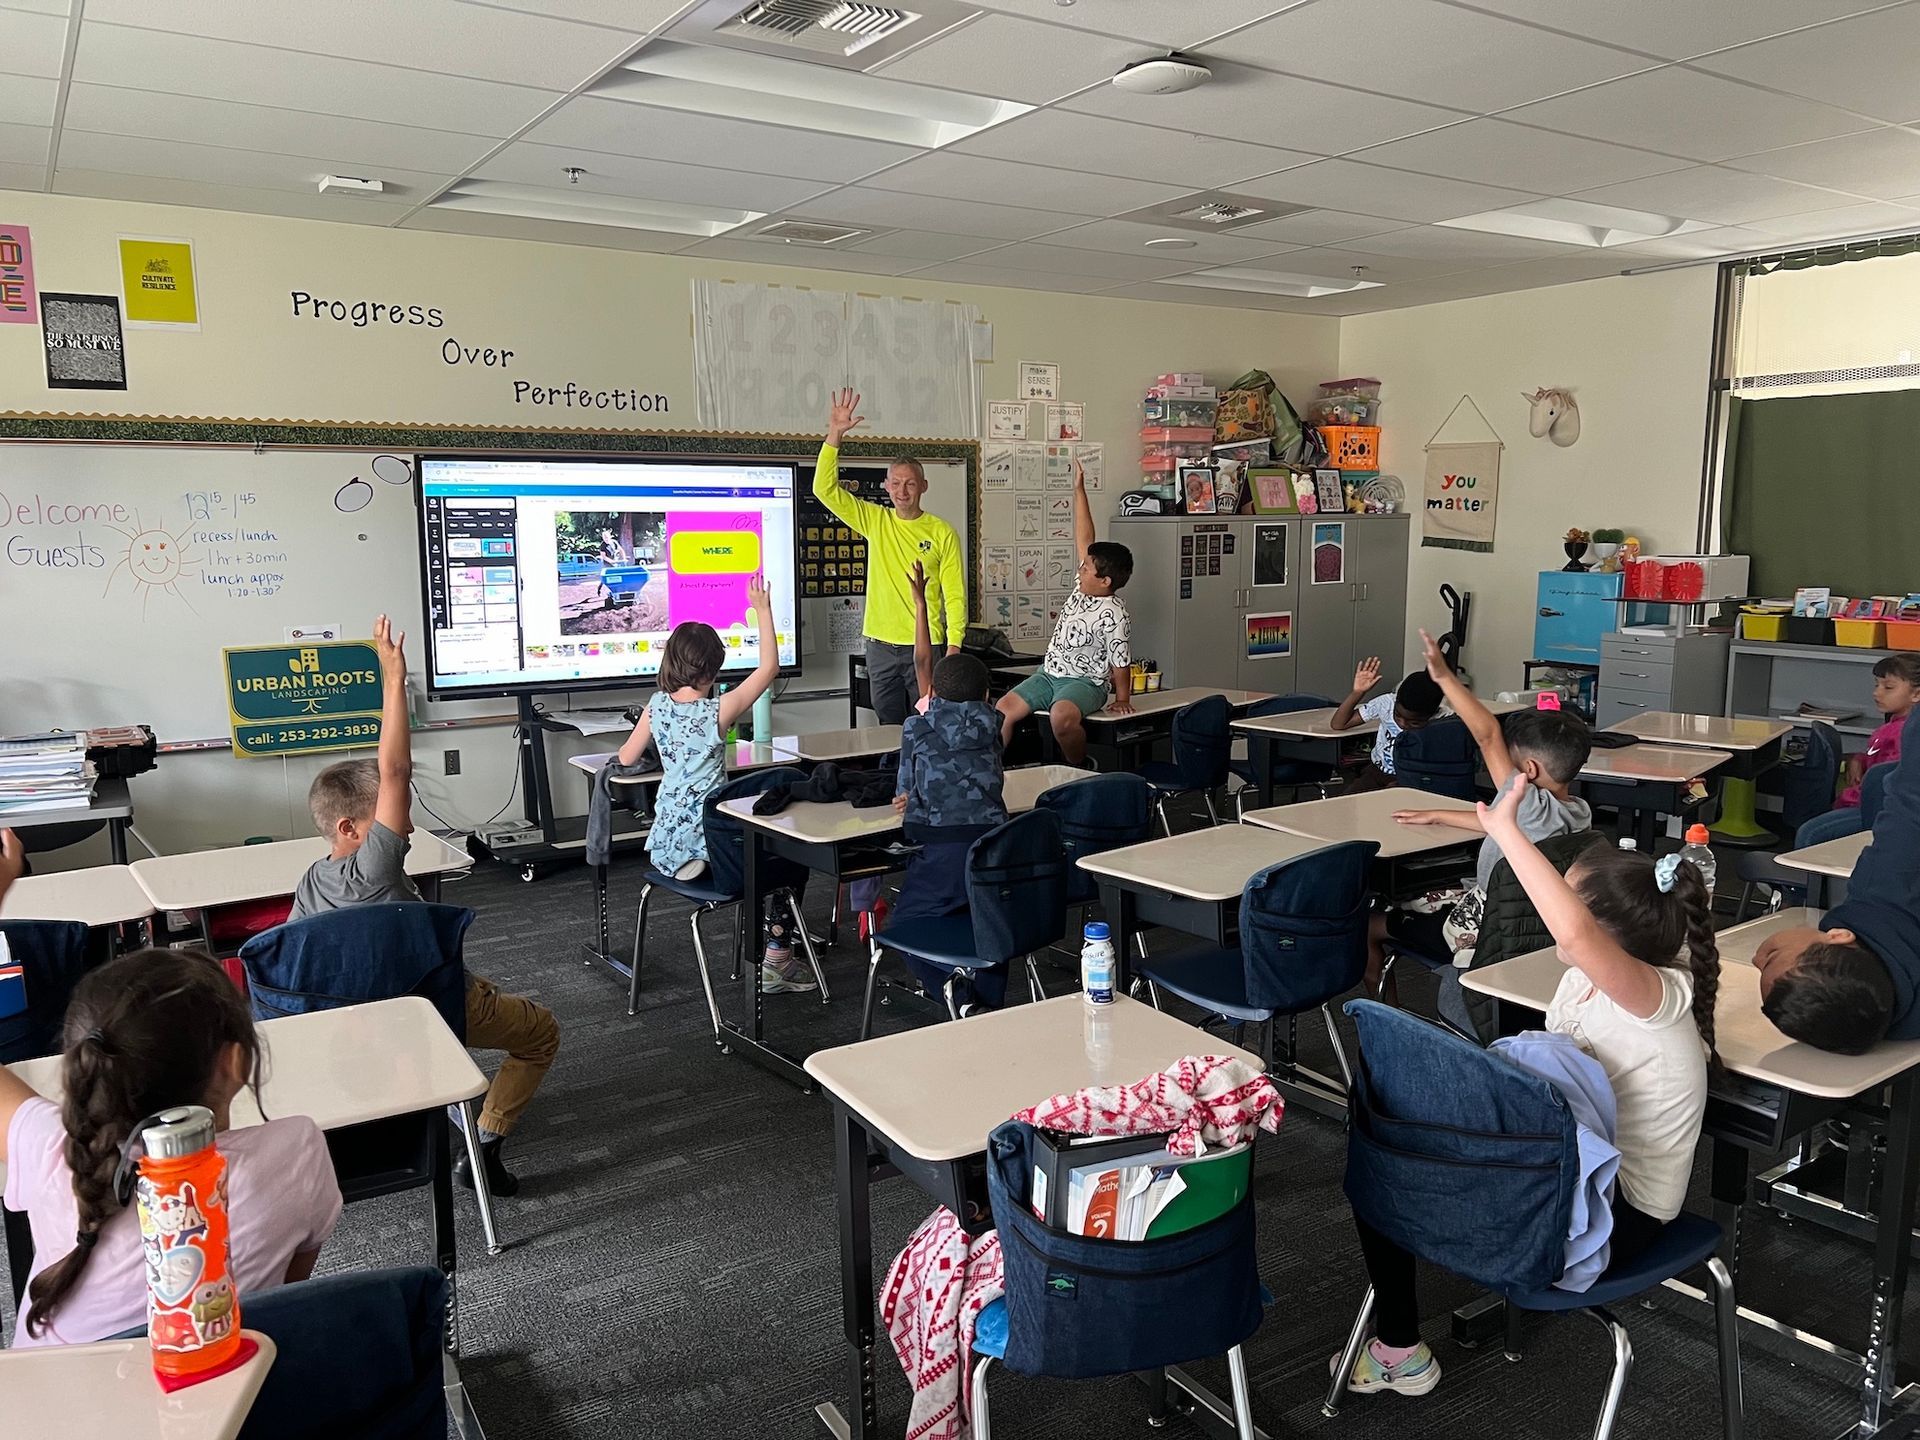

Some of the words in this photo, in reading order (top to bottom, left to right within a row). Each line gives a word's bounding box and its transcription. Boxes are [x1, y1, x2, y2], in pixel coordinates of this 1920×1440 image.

[142, 274, 175, 283] CULTIVATE
[142, 282, 176, 290] RESILIENCE
[292, 292, 444, 328] Progress
[46, 339, 64, 348] SO
[66, 340, 98, 350] MUST
[100, 340, 121, 350] WE
[442, 338, 514, 367] Over
[1028, 376, 1050, 385] SENSE
[513, 380, 669, 412] Perfection
[992, 406, 1024, 416] JUSTIFY
[1441, 474, 1476, 490] you
[1426, 497, 1490, 512] matter
[193, 527, 278, 543] recess/lunch
[7, 530, 104, 568] Guests
[201, 569, 244, 585] lunch
[250, 574, 286, 586] appox
[1258, 626, 1280, 645] RESIST
[237, 674, 306, 692] URBAN
[312, 670, 376, 687] ROOTS
[272, 686, 348, 699] LANDSCAPING
[247, 733, 274, 745] call:
[279, 724, 378, 742] 253-292-3839
[1091, 1211, 1112, 1220] VOLUME
[1093, 1219, 1108, 1238] 2
